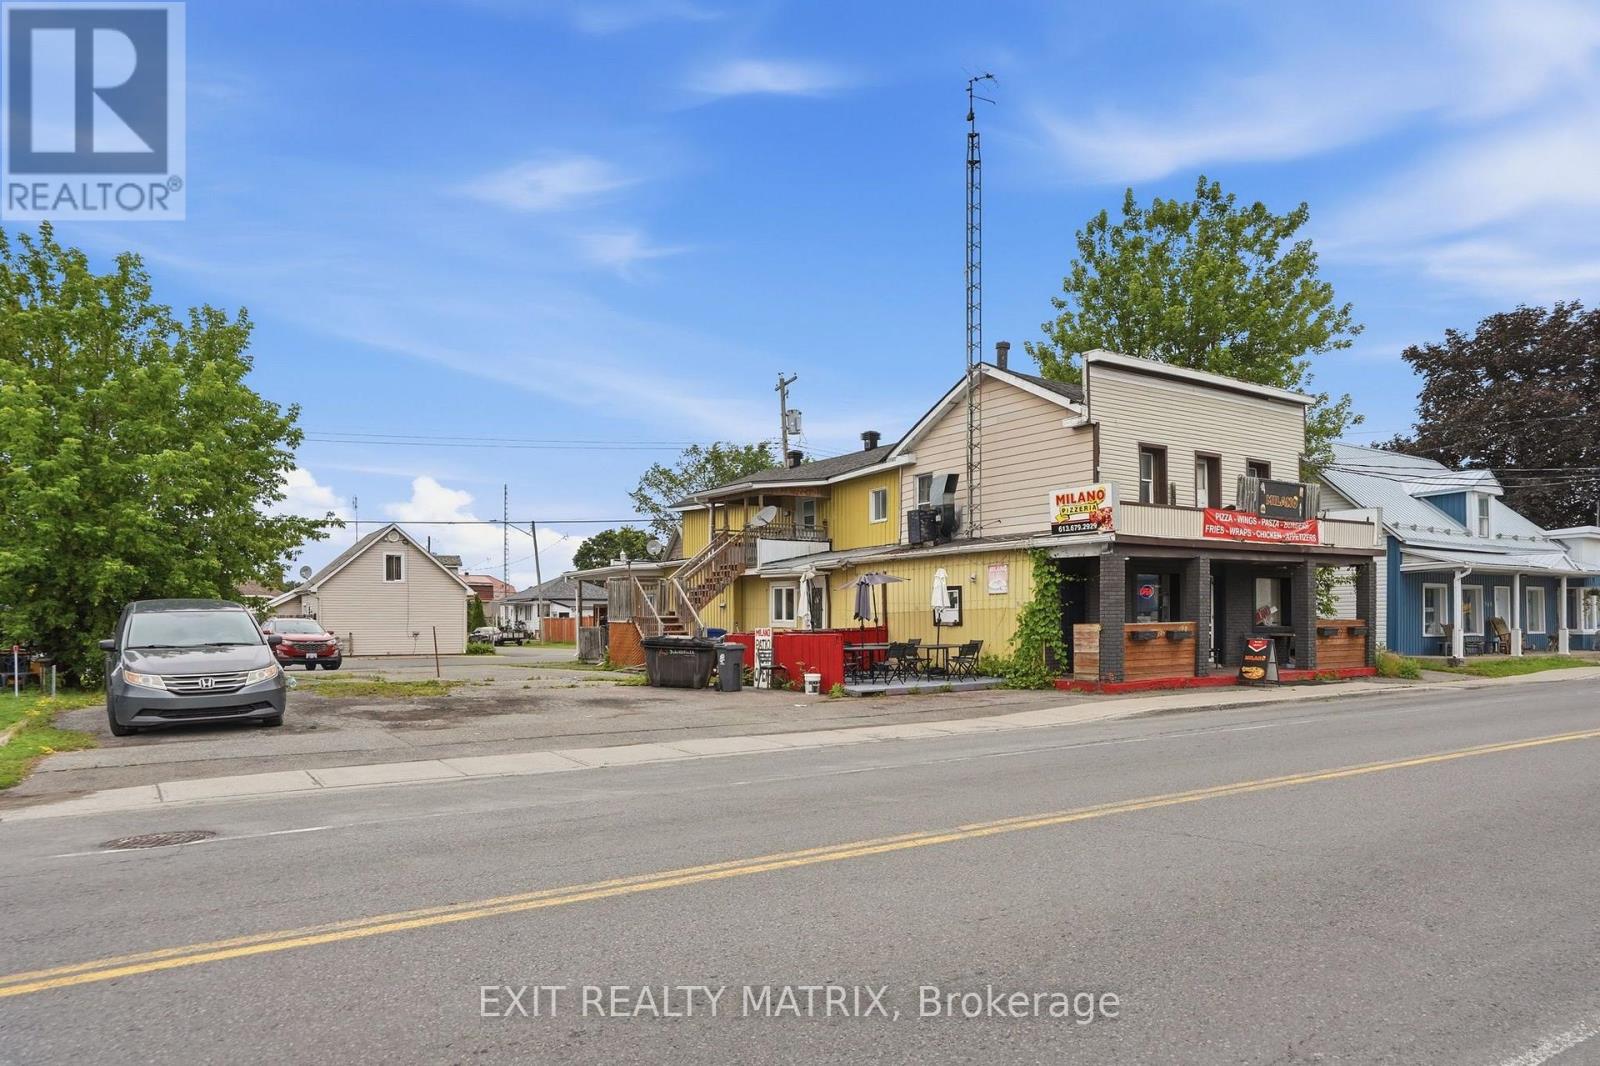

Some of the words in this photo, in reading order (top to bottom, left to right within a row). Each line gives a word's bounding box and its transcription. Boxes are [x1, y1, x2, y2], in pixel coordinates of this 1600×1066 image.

[1056, 489, 1105, 506] MILANO
[1061, 504, 1097, 513] PIZZERIA
[1215, 512, 1233, 522] PIZZA
[1237, 515, 1257, 525] WINGS
[1261, 518, 1280, 527] PASTA
[1205, 525, 1225, 534] FRIES
[1229, 527, 1251, 537] WRAPS
[1256, 530, 1282, 539] CHICKEN
